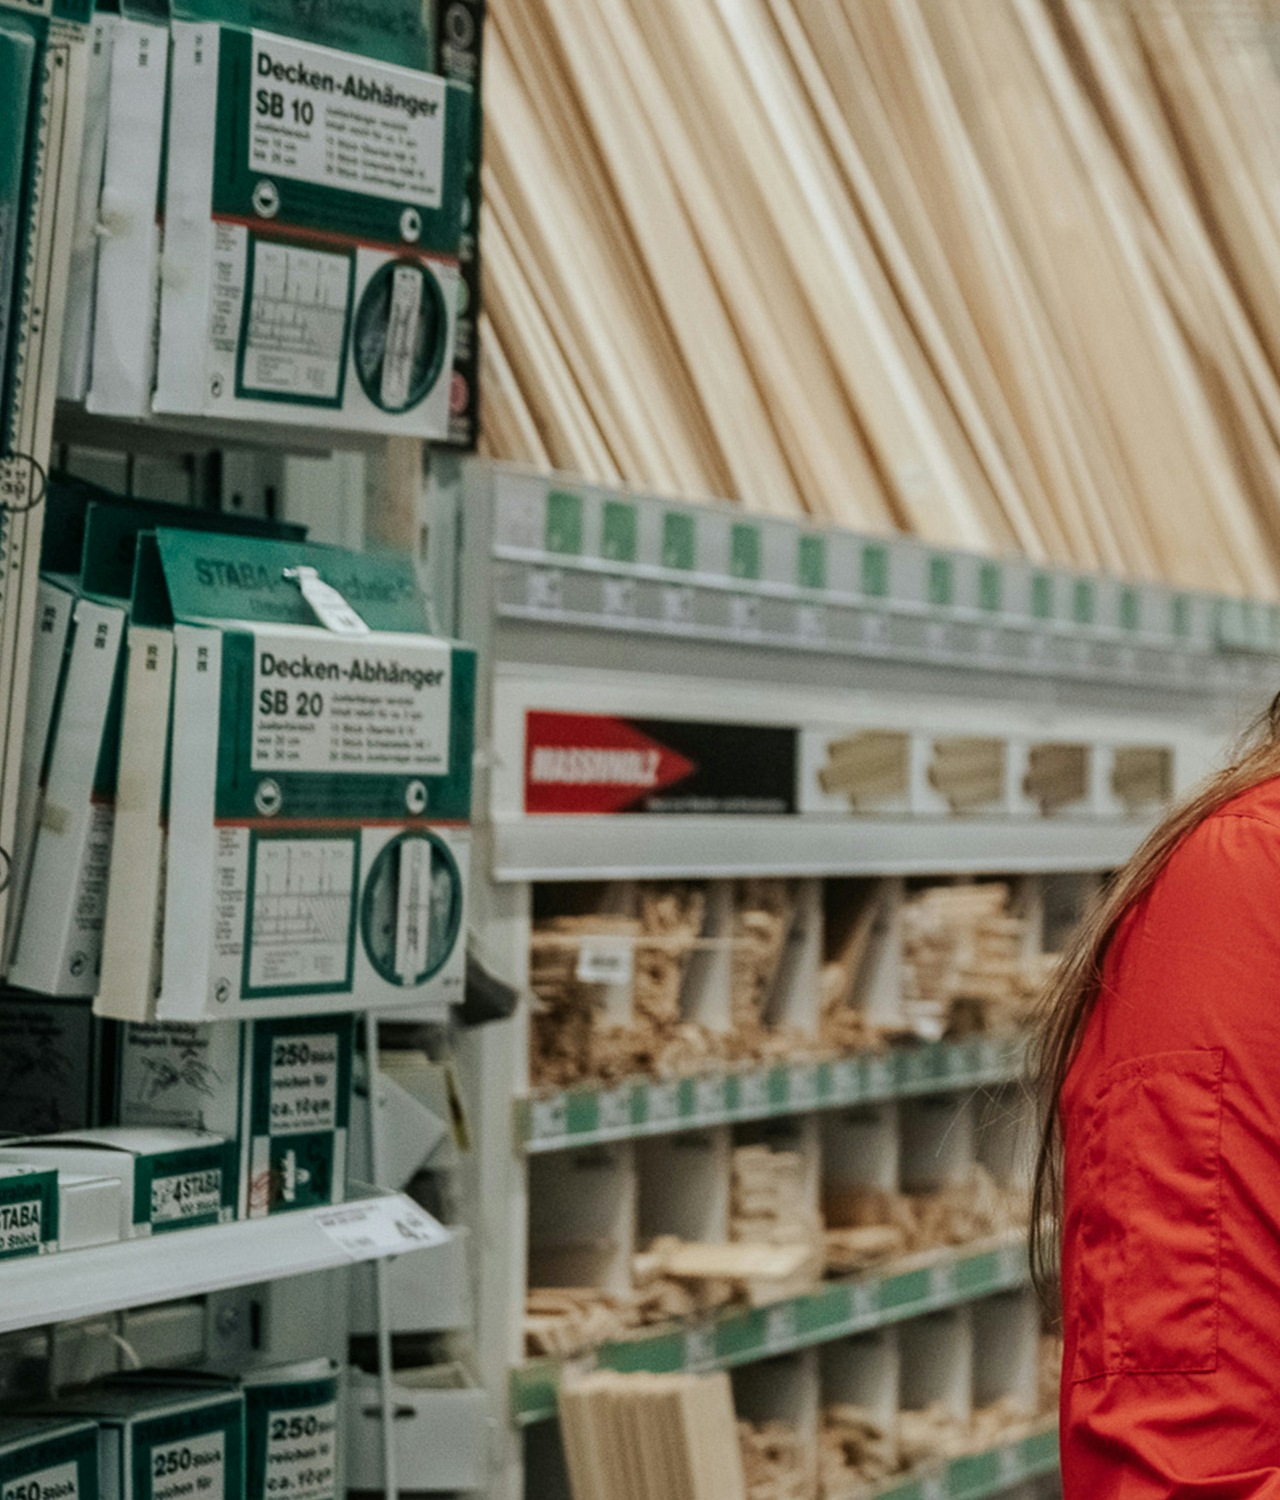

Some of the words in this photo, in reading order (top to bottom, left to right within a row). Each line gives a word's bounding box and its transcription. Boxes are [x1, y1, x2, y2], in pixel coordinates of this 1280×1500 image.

[257, 52, 439, 119] Decken-Abhänger
[256, 89, 285, 119] SB
[293, 98, 314, 125] 10
[260, 652, 445, 691] Decken-Abhänger
[259, 688, 288, 716] SB
[296, 692, 323, 718] 20
[274, 1042, 311, 1067] 250
[0, 1204, 40, 1231] TABA
[271, 1415, 317, 1441] 250
[154, 1448, 192, 1478] 250
